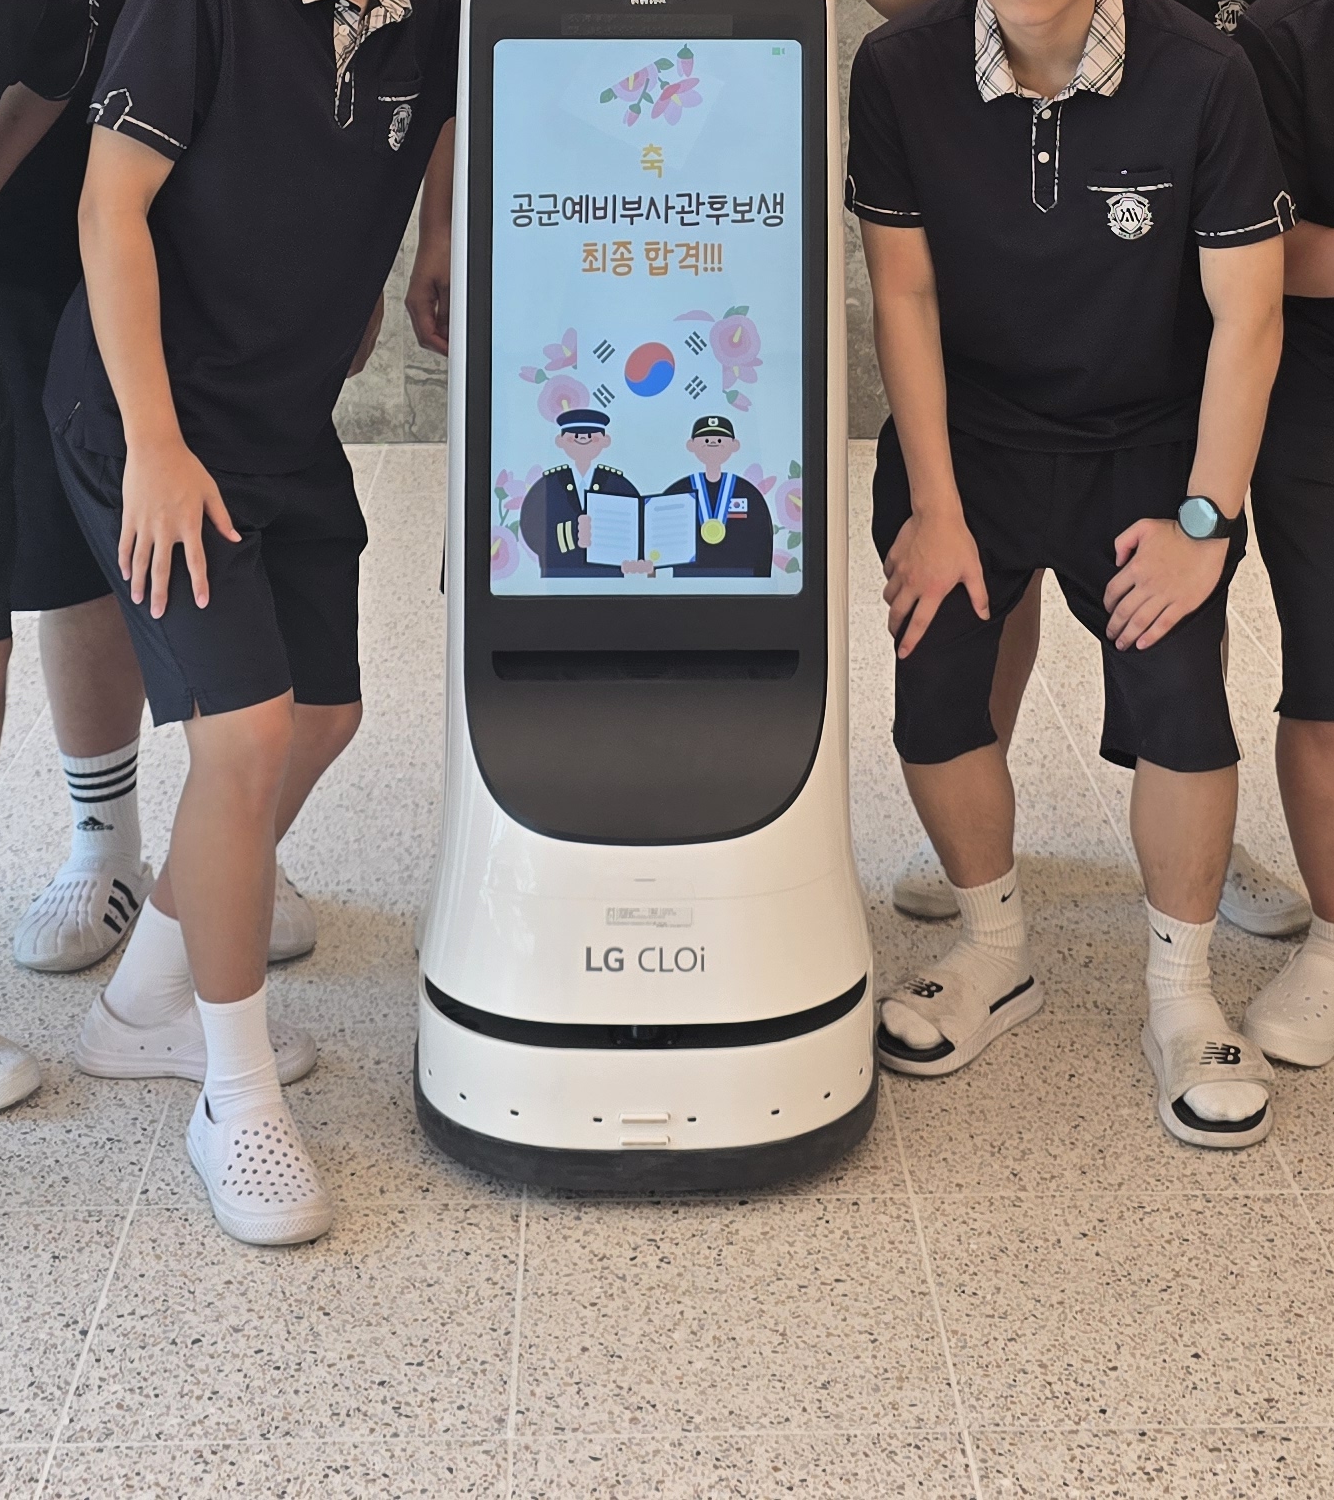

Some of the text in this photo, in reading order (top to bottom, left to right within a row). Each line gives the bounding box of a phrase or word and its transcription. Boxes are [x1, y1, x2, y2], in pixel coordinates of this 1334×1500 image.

[640, 143, 665, 179] 축
[509, 192, 785, 228] 공군예비부사관후보생
[580, 241, 723, 277] 최종 합격!!!
[585, 946, 705, 972] LG CLOi
